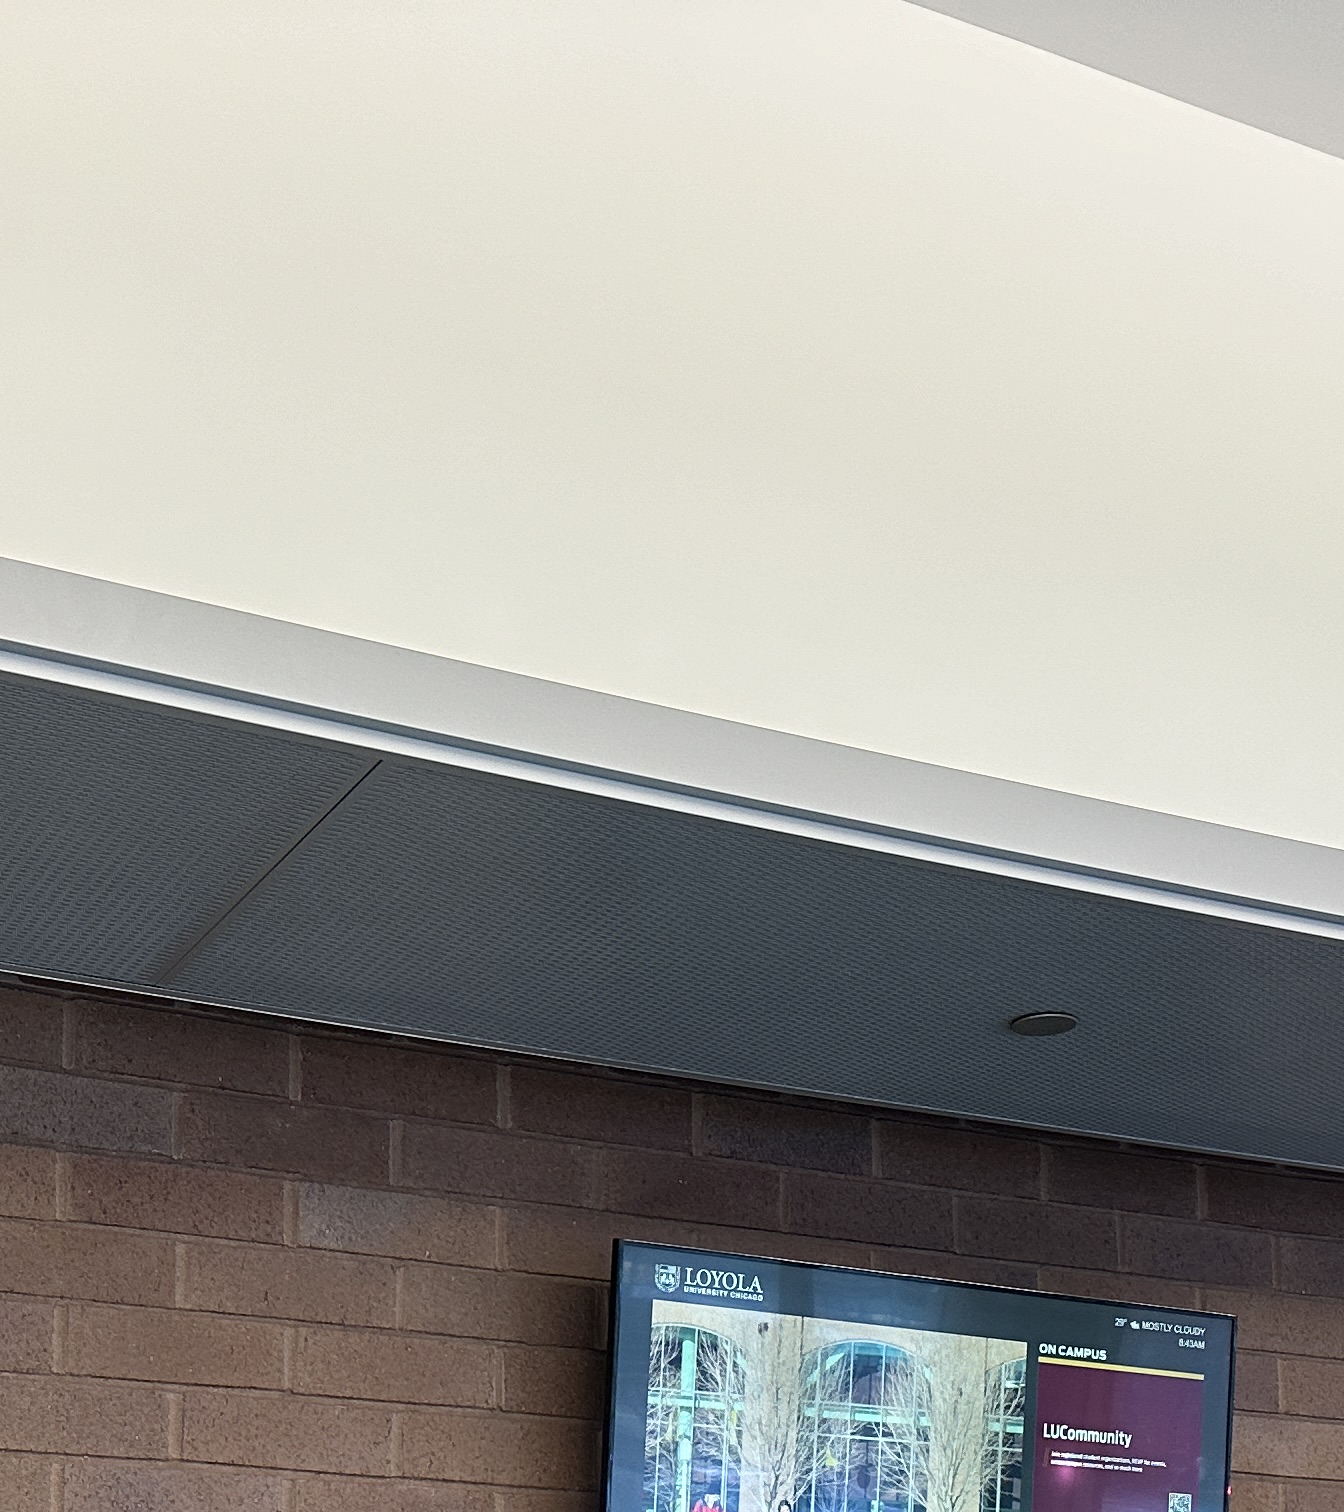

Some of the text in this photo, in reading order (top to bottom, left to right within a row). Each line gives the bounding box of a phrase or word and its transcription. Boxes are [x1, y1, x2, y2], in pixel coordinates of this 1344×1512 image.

[684, 1267, 763, 1293] LOYOLA
[683, 1285, 764, 1302] UNIVERSITY CHICAGO
[1141, 1320, 1173, 1333] MOSTLY
[1174, 1324, 1206, 1336] CLOUDY
[1039, 1343, 1107, 1361] ON CAMPUS
[1043, 1422, 1133, 1449] LUCommunity
